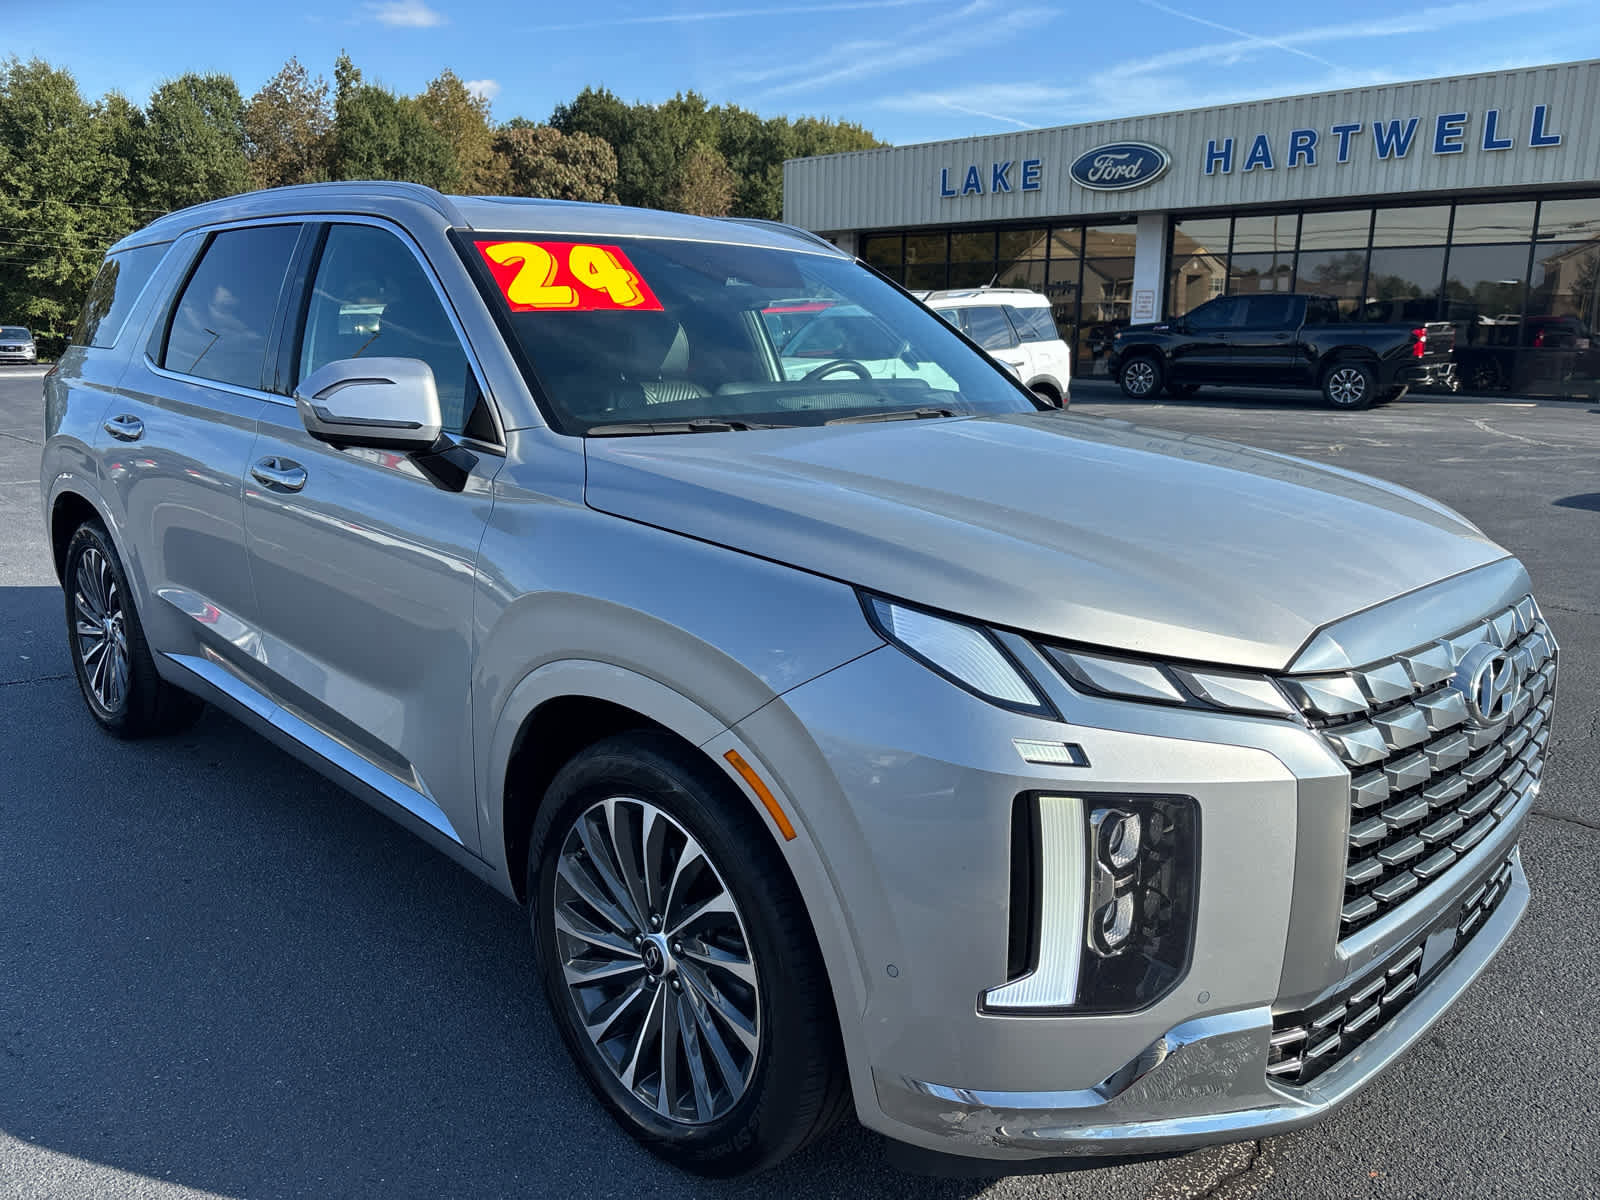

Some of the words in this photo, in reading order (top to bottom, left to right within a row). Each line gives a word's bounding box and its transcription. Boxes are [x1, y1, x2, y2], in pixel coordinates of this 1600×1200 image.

[940, 158, 1042, 198] LAKE
[1088, 152, 1144, 182] Ford
[1204, 103, 1562, 175] HARTWELL
[485, 241, 645, 308] 24
